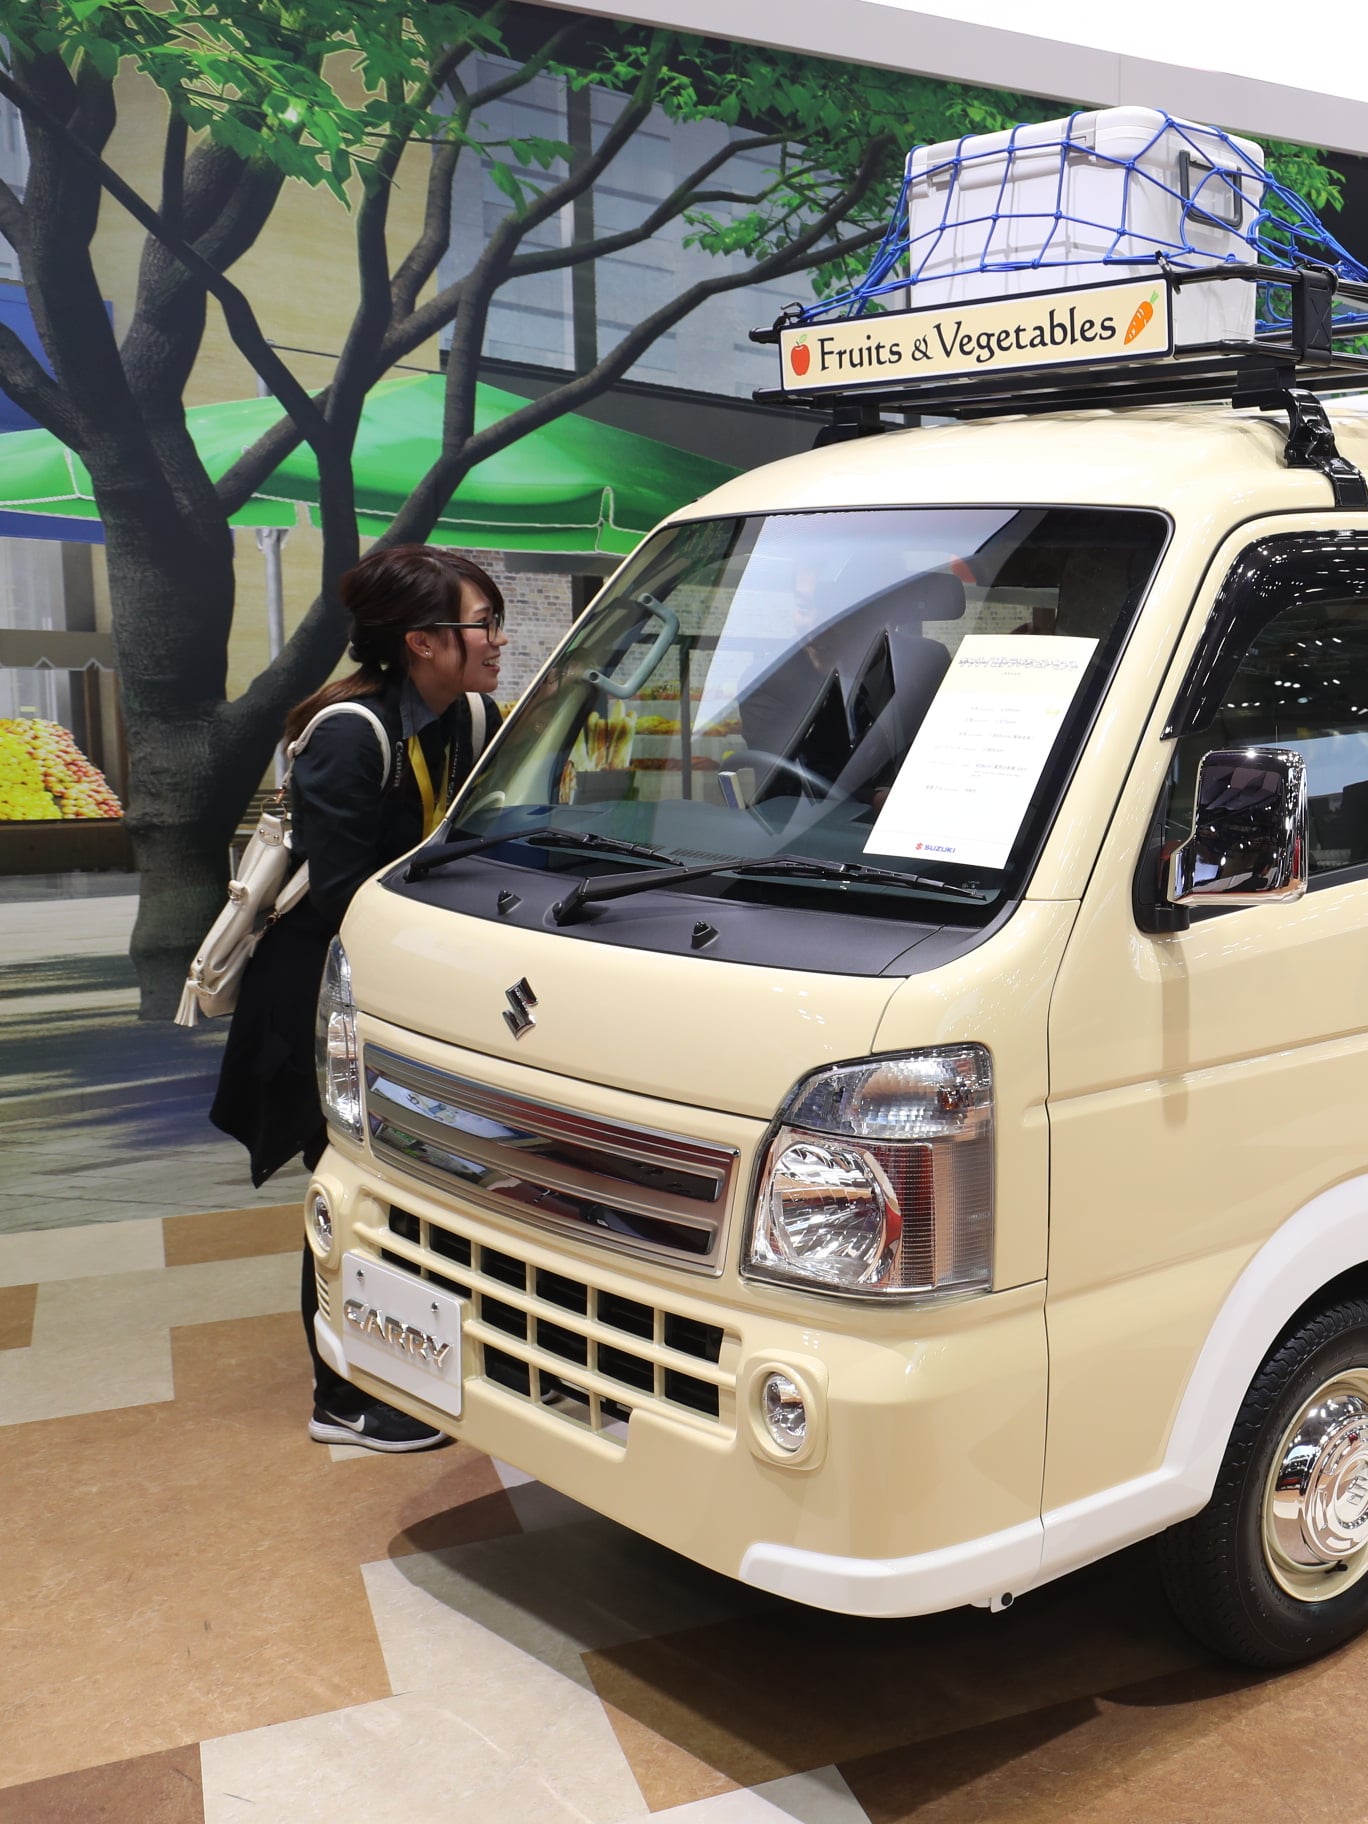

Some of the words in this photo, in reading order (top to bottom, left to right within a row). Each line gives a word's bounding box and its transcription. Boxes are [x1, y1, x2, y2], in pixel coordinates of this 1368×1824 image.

[817, 333, 902, 372] Fruits
[911, 334, 934, 361] &
[933, 306, 1117, 363] Vegetables
[924, 844, 956, 854] SUZUKI
[344, 1299, 454, 1368] CARRY
